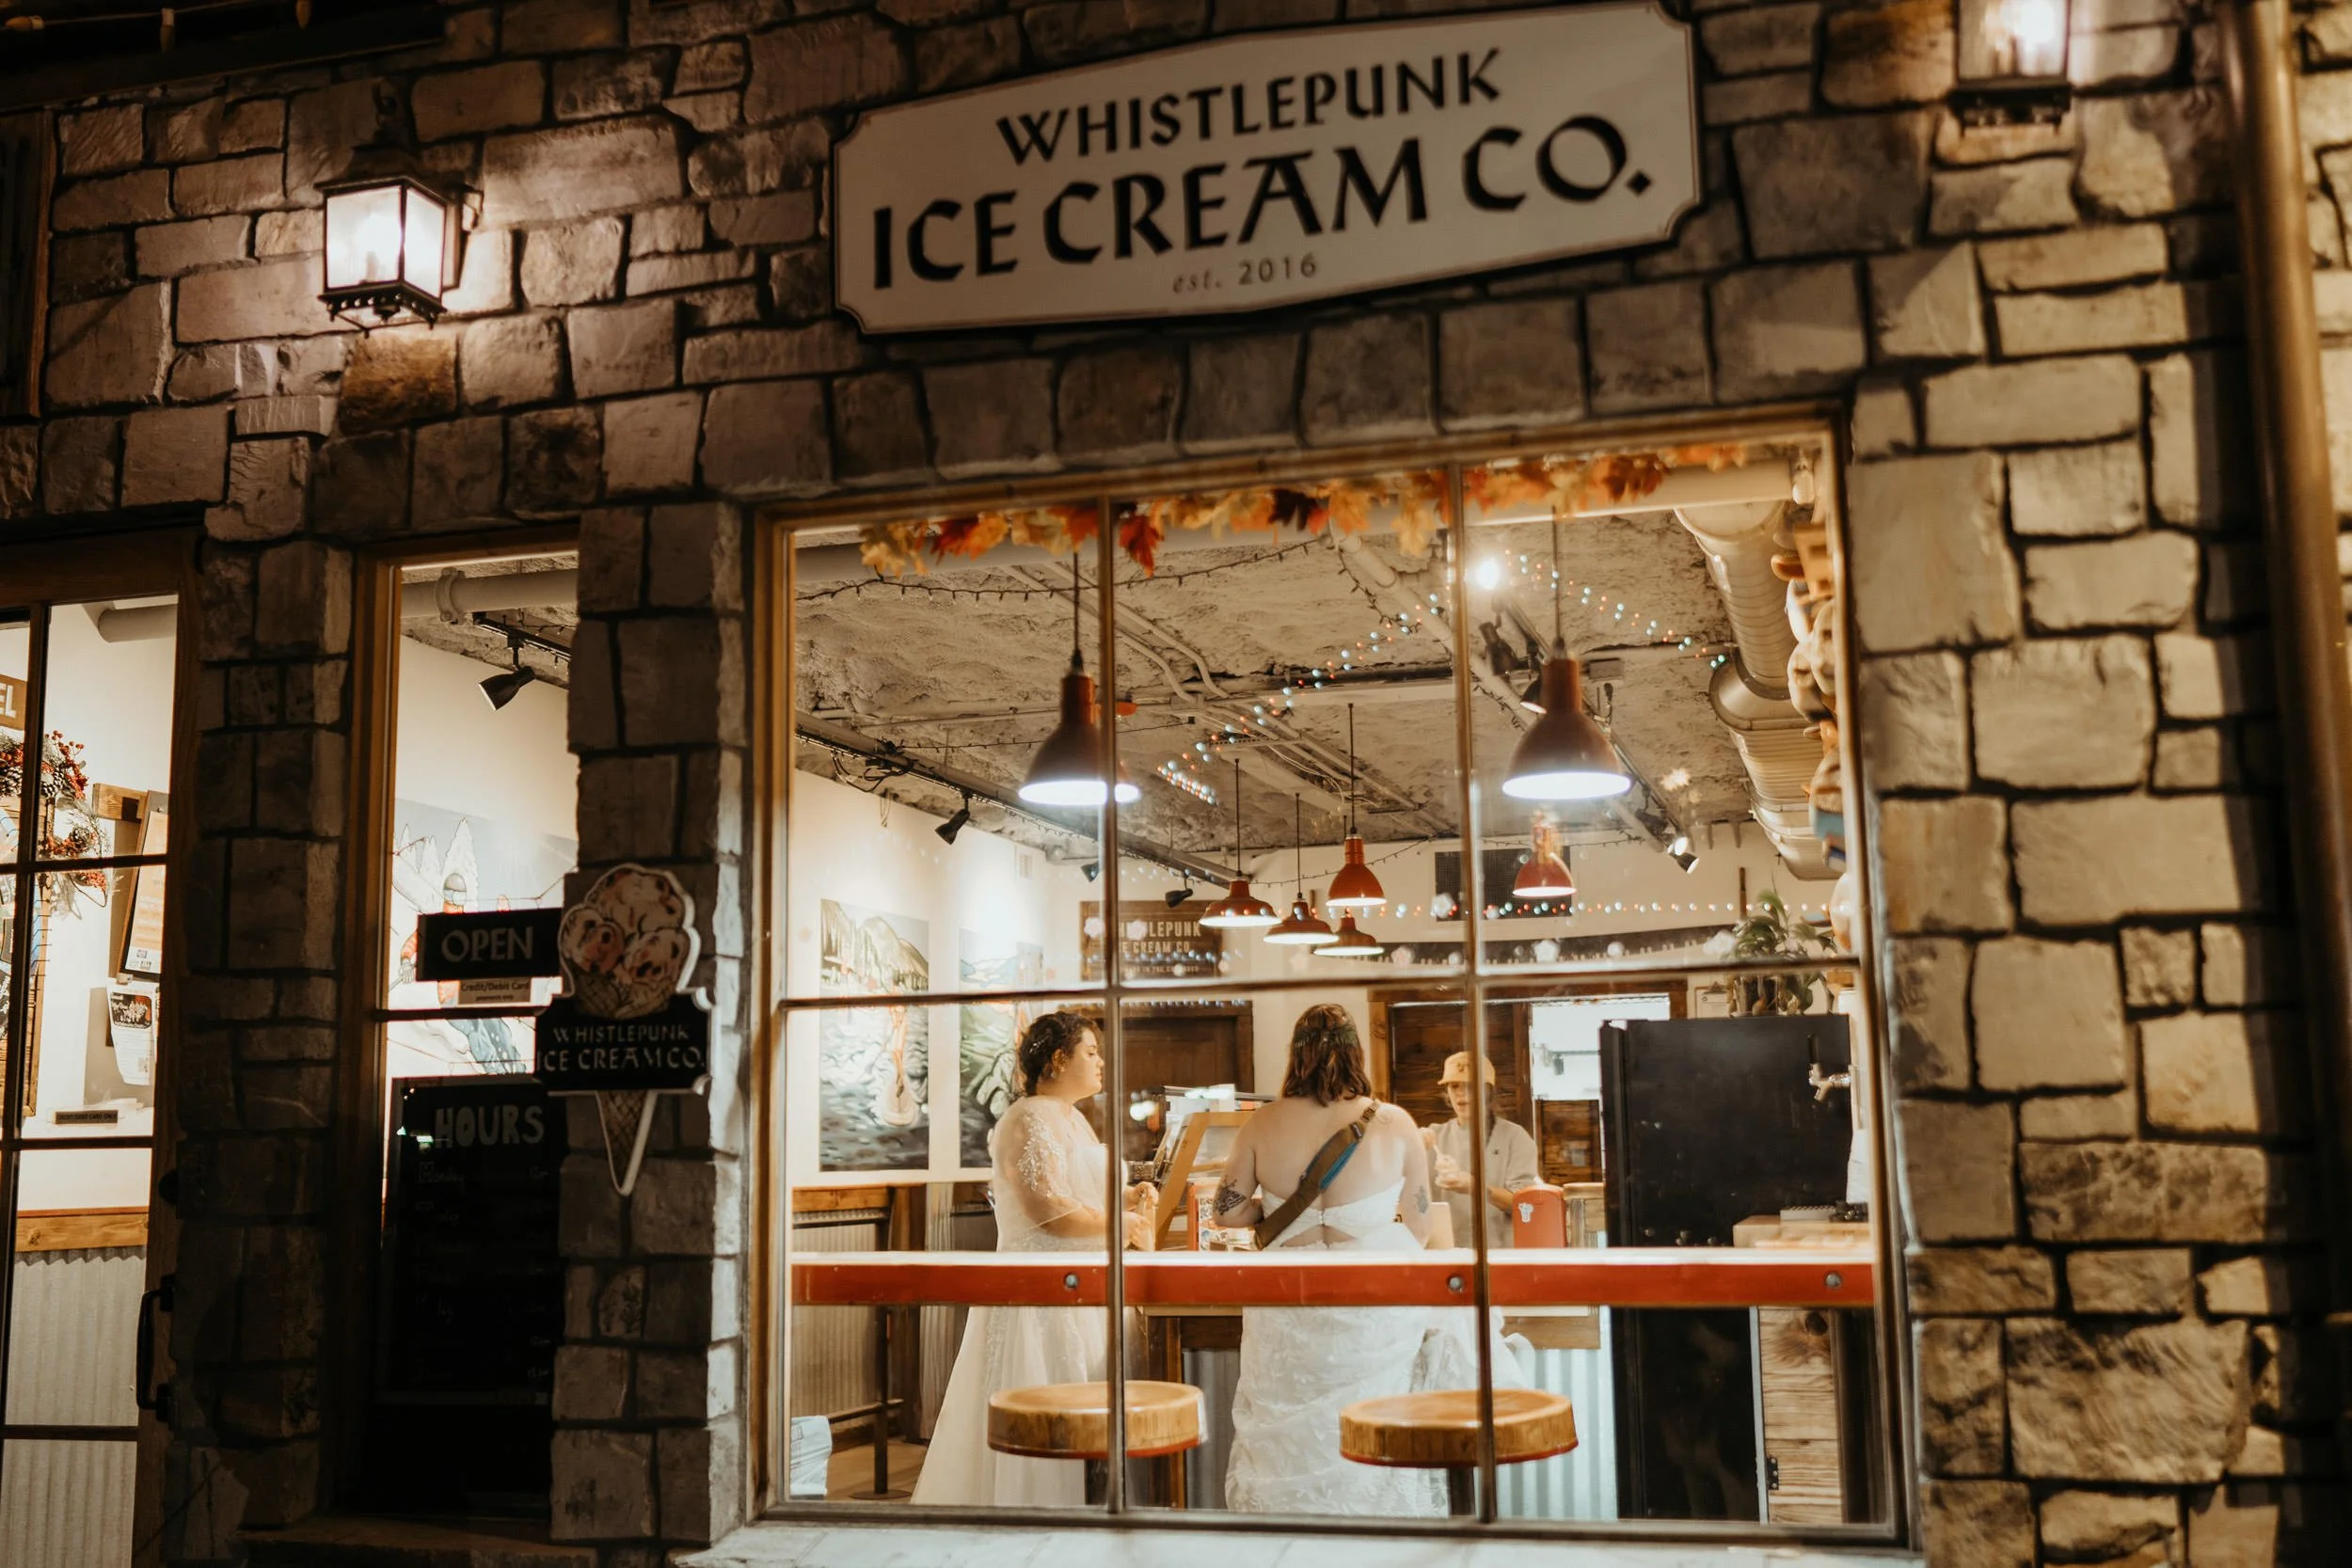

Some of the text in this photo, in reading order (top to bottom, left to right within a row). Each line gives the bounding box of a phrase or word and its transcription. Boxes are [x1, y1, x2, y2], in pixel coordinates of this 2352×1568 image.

[996, 47, 1502, 166] WHISTLEPUNK
[872, 114, 1652, 290] ICE CREAM CO.
[1171, 251, 1318, 293] est. 2016
[441, 926, 533, 963] OPEN
[553, 1023, 690, 1043] WHISTLEPUNK
[579, 1046, 661, 1069] CREAM
[434, 1105, 545, 1148] HOURS
